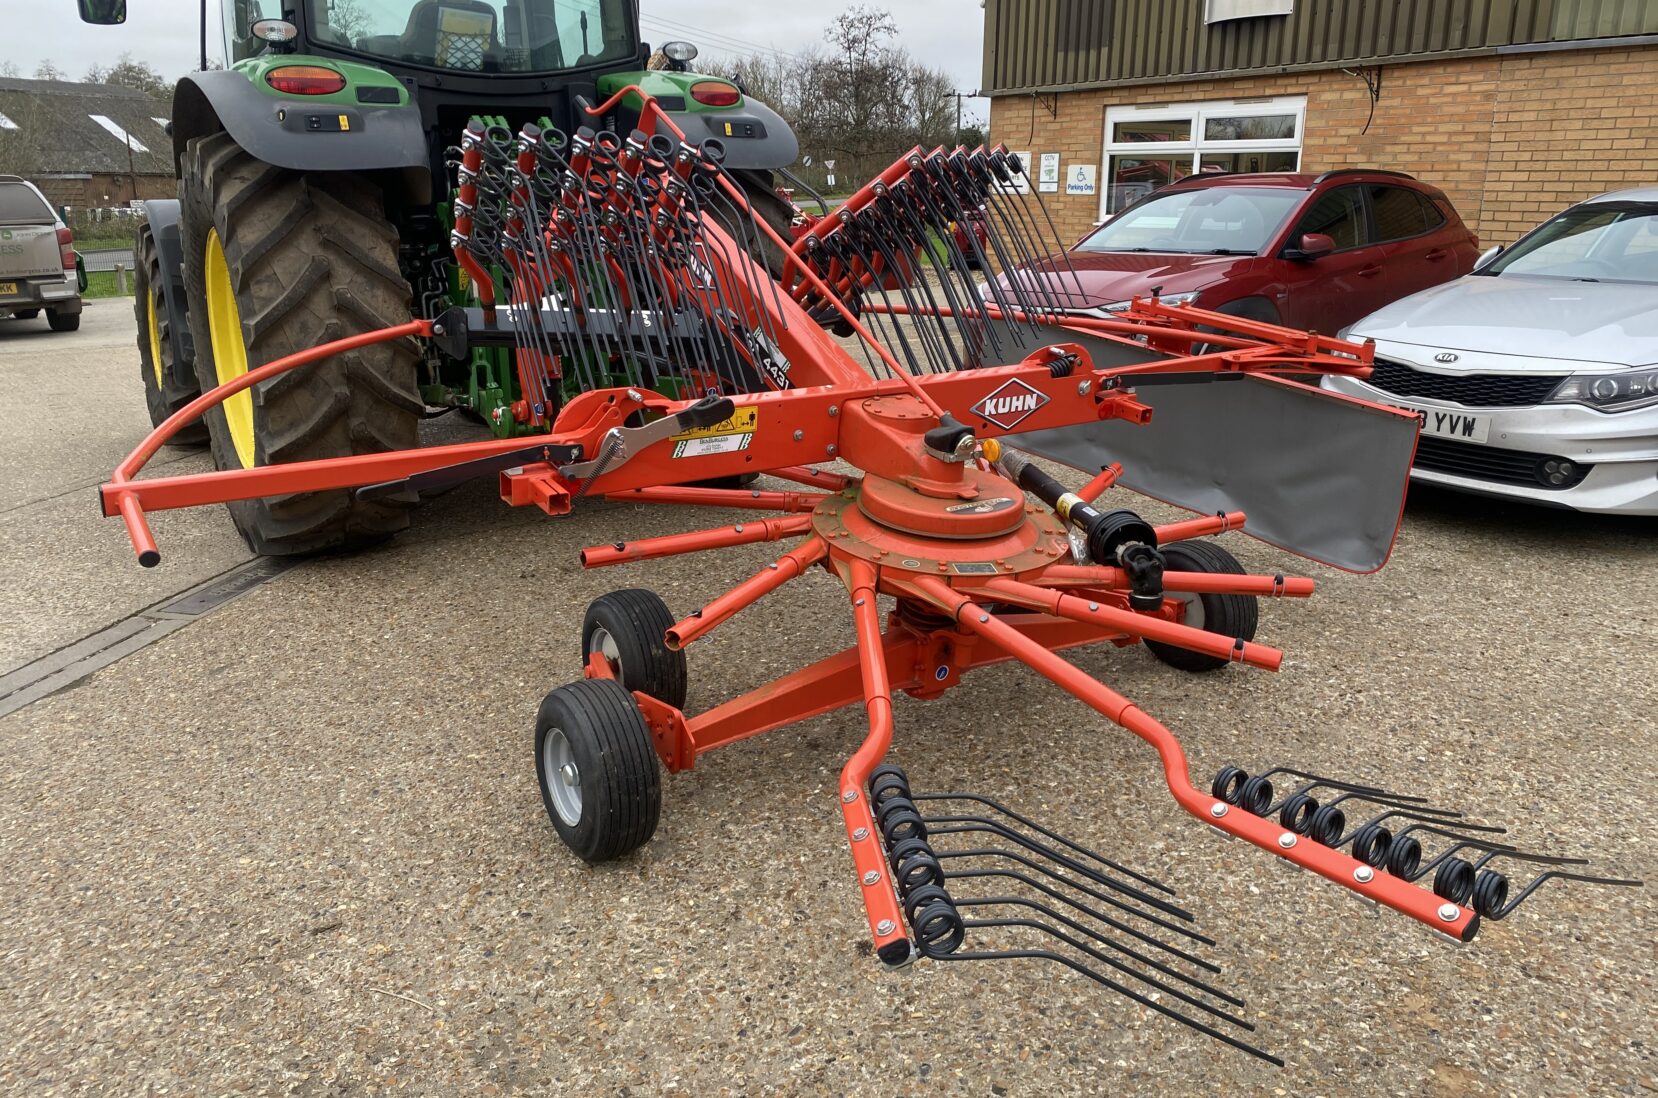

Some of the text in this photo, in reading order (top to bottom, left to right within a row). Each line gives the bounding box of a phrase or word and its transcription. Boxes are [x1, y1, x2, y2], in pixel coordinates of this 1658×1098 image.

[1068, 184, 1094, 192] Parking Only
[1437, 354, 1455, 362] KIA
[763, 358, 789, 391] 4431
[984, 393, 1038, 416] KUHN
[1435, 412, 1477, 437] YVW
